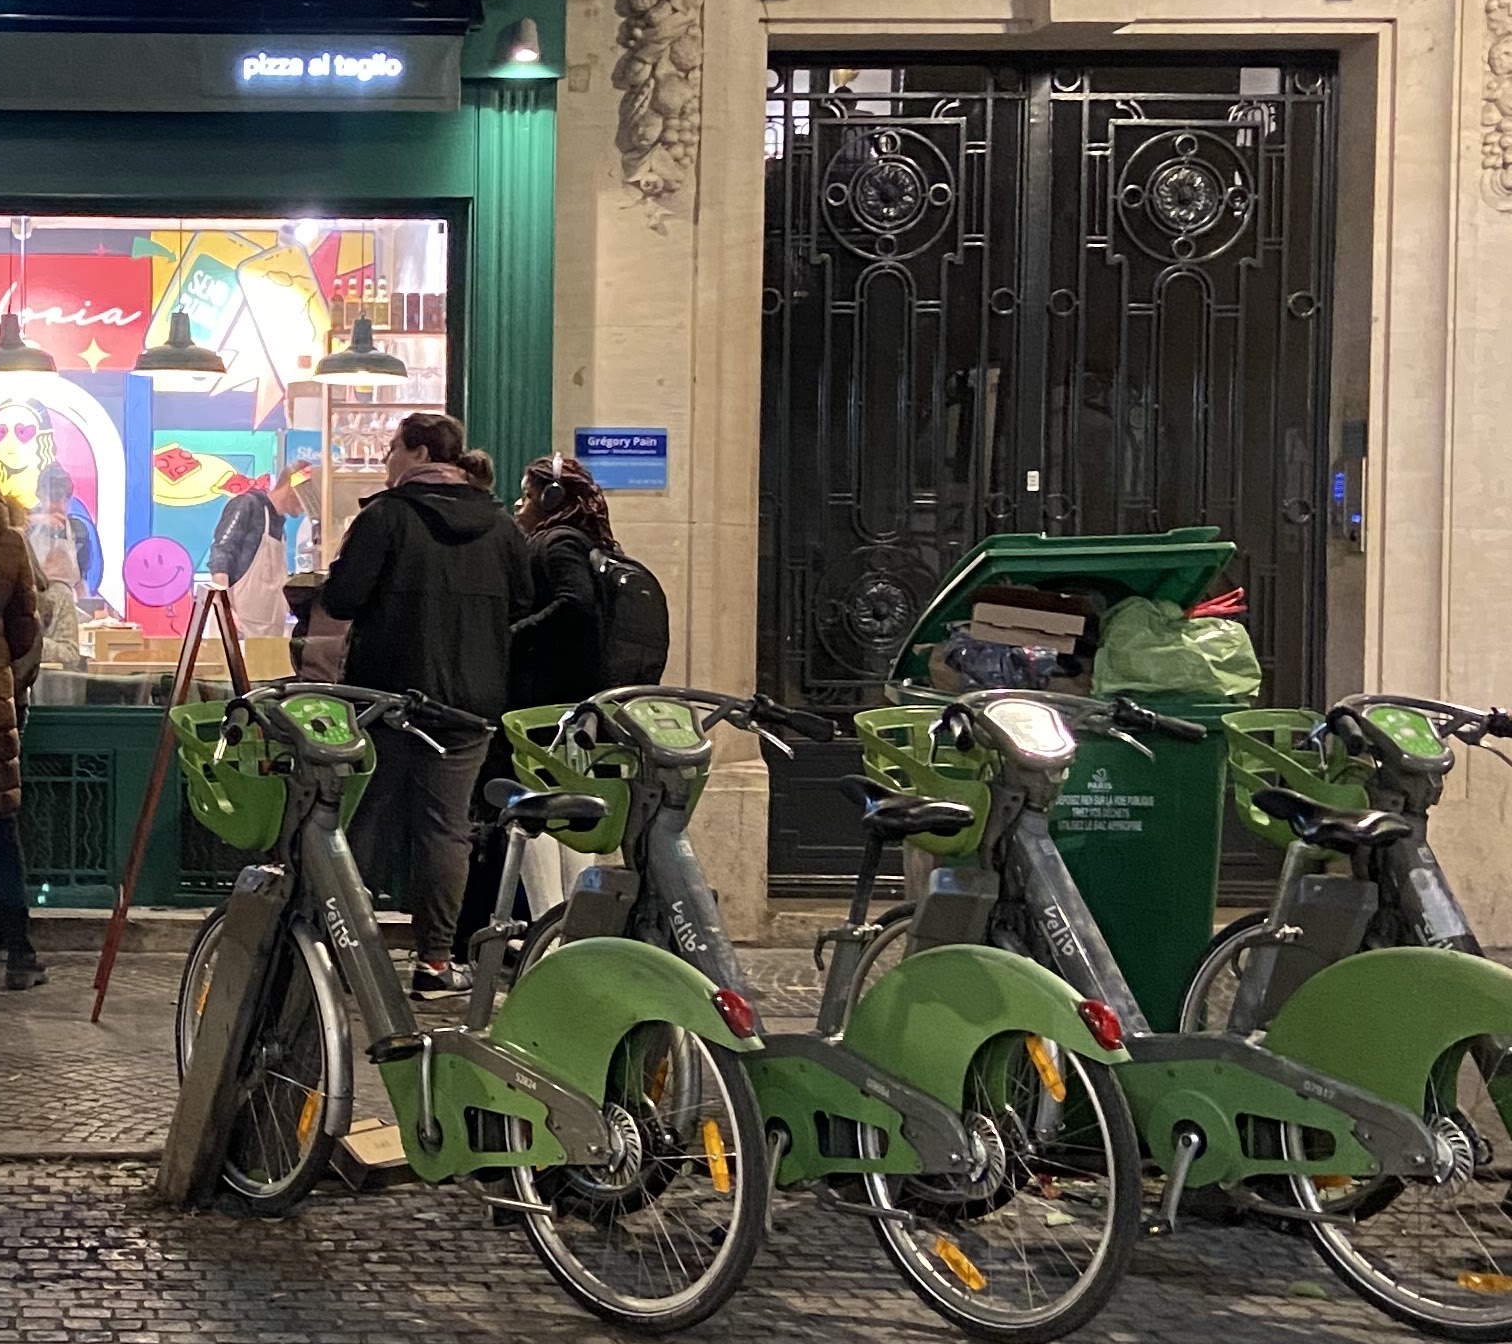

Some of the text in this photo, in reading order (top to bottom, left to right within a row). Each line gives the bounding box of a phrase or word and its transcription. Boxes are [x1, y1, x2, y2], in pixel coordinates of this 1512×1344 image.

[243, 52, 403, 82] pizza al taglio
[588, 436, 657, 449] Grégory Pain
